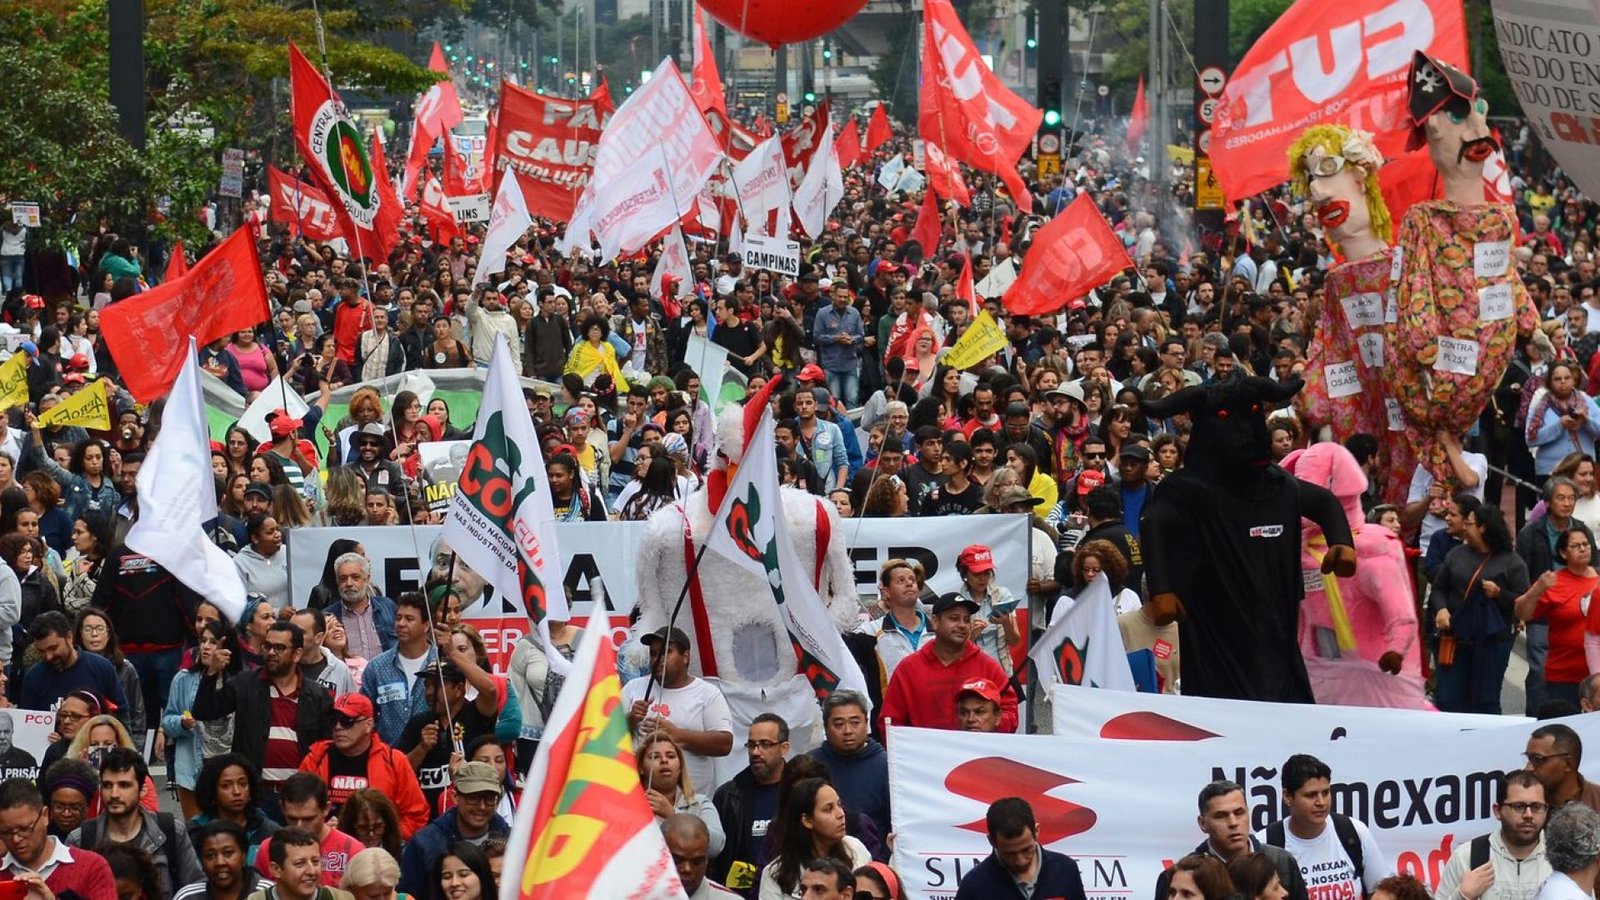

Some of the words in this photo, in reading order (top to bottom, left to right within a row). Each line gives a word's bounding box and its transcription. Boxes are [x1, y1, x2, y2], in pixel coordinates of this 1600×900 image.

[1496, 18, 1590, 57] NDICATO
[1533, 55, 1565, 82] DO
[1569, 60, 1600, 88] EN
[1553, 86, 1586, 112] DE
[313, 111, 332, 155] CENTRAL
[457, 208, 478, 221] LINS
[747, 250, 797, 273] CAMPINAS
[1440, 341, 1474, 352] CONTRA
[454, 511, 468, 527] NAS
[25, 713, 53, 725] PCO
[333, 776, 367, 790] NÃO
[1312, 859, 1350, 873] MEXAM
[1311, 871, 1351, 885] NOSSOS
